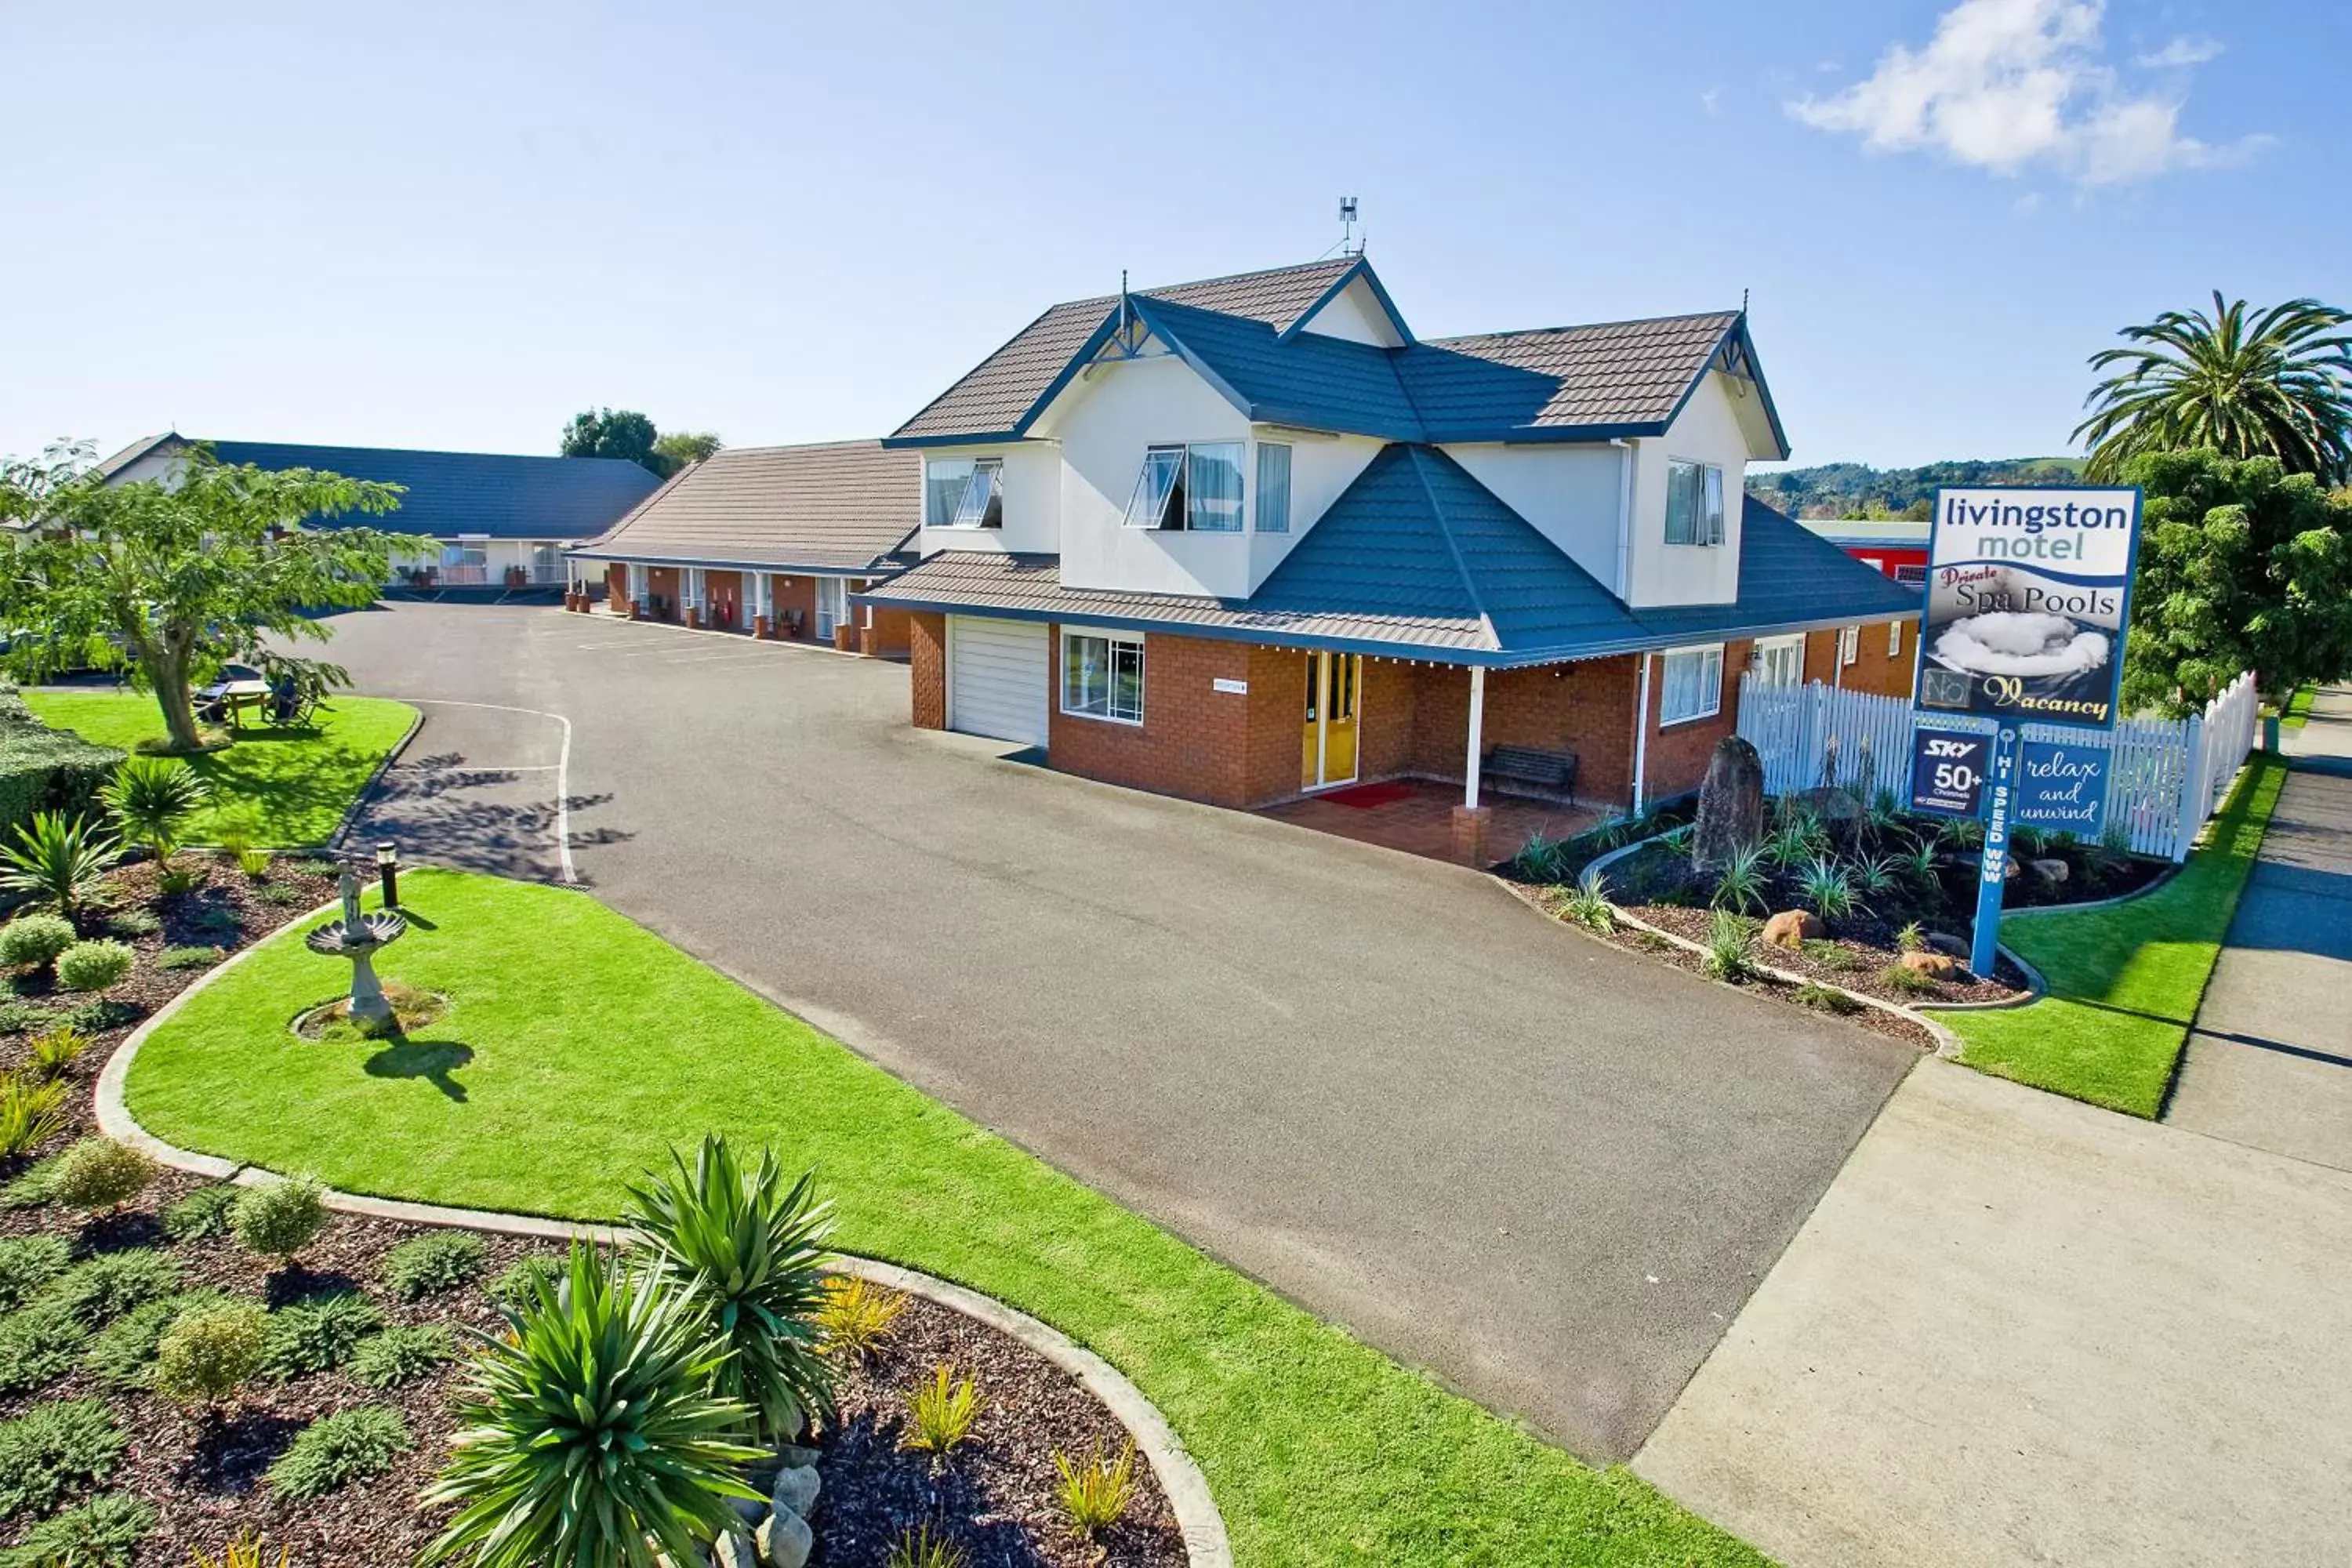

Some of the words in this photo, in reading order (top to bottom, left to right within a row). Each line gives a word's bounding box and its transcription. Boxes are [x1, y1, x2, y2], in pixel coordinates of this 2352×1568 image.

[1947, 498, 2127, 534] livingston
[1976, 532, 2084, 561] motel
[1940, 564, 1998, 589] Private
[1956, 583, 2013, 614] Spa
[2024, 587, 2115, 615] Pools
[1983, 675, 2109, 720] Vacancy
[1924, 739, 1977, 758] SKY
[1934, 763, 1983, 791] 50+
[2027, 752, 2101, 784] relax
[2039, 782, 2082, 804] and
[2020, 800, 2098, 822] unwind
